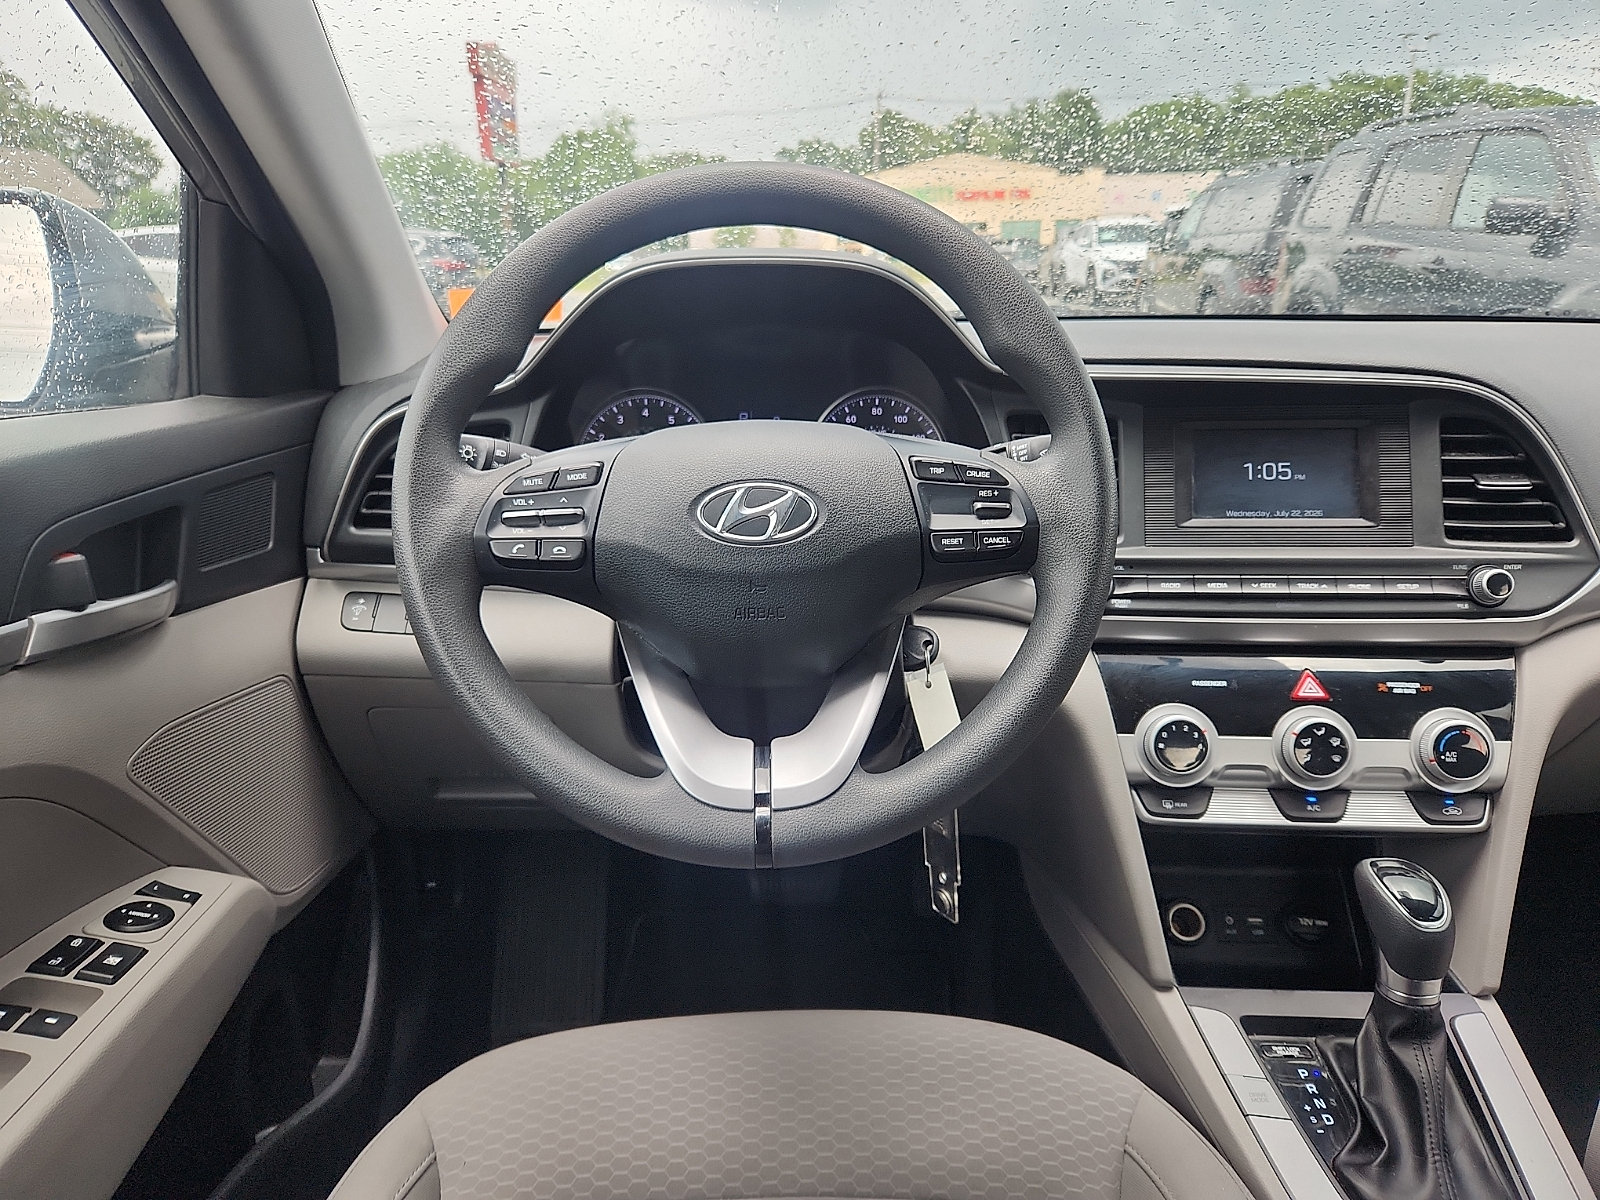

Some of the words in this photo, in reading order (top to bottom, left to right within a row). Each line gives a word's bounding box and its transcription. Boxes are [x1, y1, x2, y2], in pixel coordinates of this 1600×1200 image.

[642, 408, 649, 417] 4
[617, 415, 624, 424] 3
[667, 416, 675, 424] 5
[567, 472, 588, 481] MODE
[966, 470, 991, 478] CRUISE
[1243, 462, 1292, 481] 1:05
[523, 478, 543, 486] MUTE
[733, 606, 786, 621] AIRBAG
[1297, 1069, 1309, 1080] P
[1305, 1083, 1319, 1095] R
[1313, 1098, 1327, 1110] N
[1321, 1113, 1334, 1126] D
